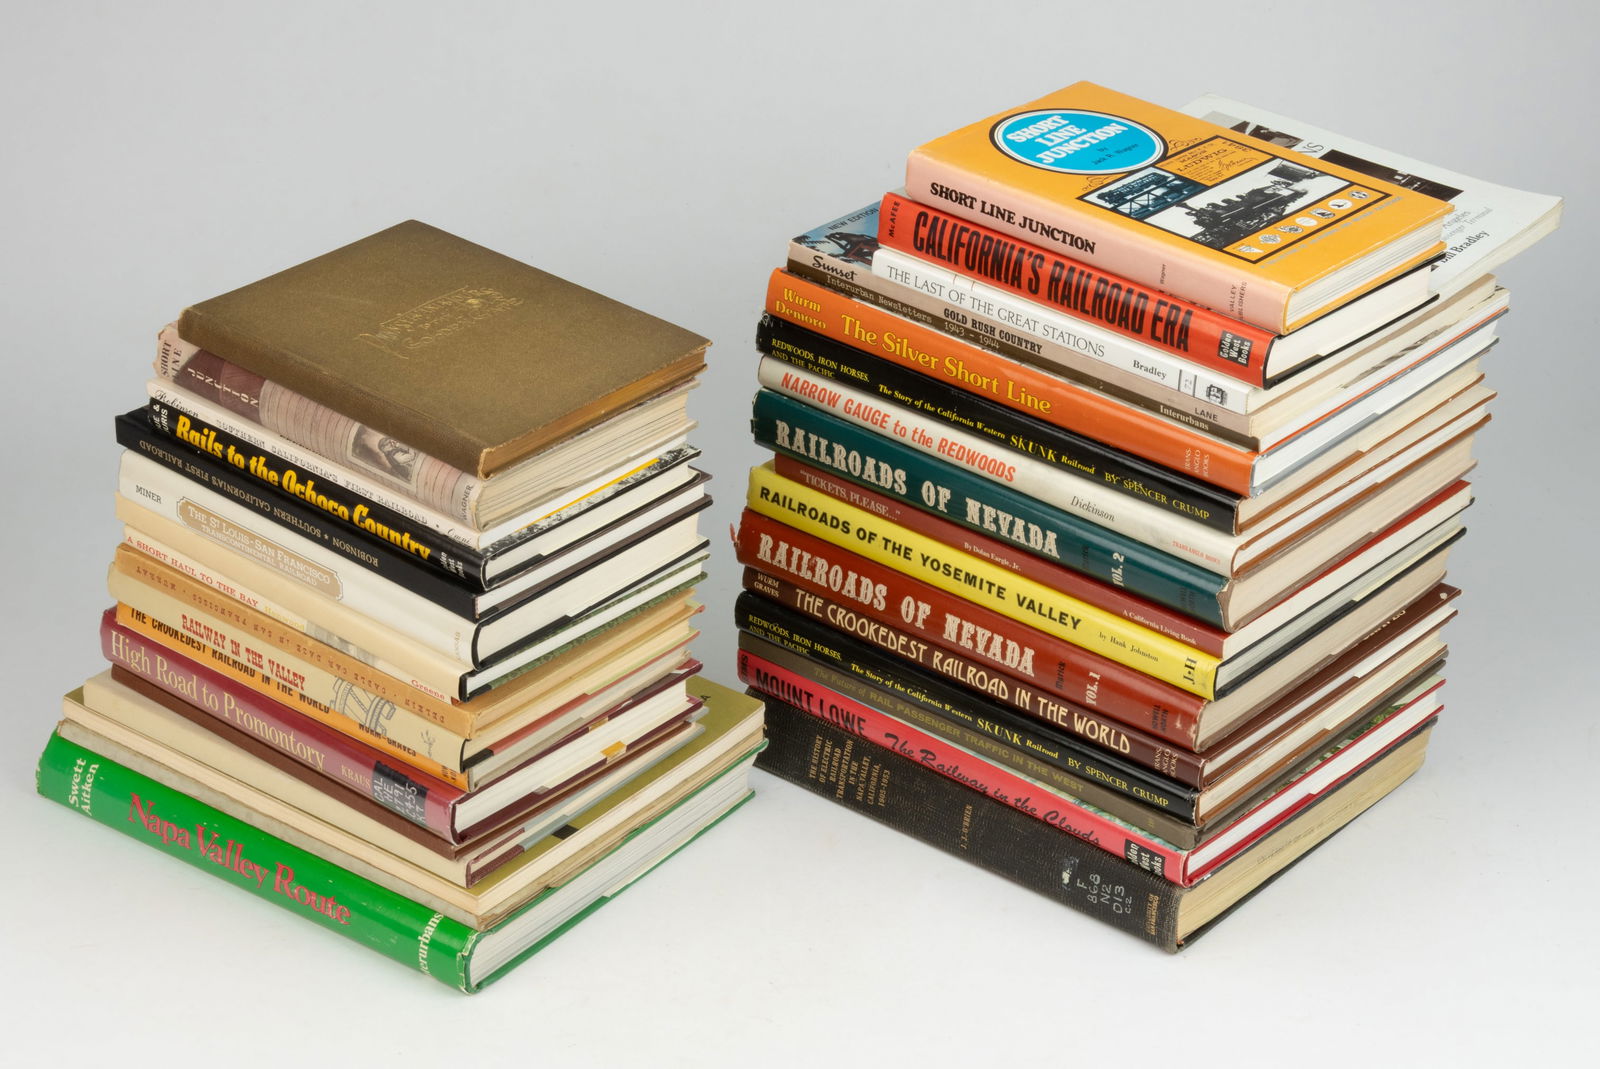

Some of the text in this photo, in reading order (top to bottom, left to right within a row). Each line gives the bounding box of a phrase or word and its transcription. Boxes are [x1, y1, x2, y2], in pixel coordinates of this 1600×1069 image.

[1006, 115, 1070, 142] SHORT
[1035, 125, 1087, 147] LINE
[1036, 123, 1129, 164] JUNCTION
[828, 207, 880, 232] NEW EDITION
[889, 201, 900, 238] McAFEE
[930, 182, 1096, 255] SHORT LINE JUNCTION
[812, 255, 858, 282] Sunset
[913, 211, 1194, 353] CALIFORNIA'S RAILROAD ERA
[775, 300, 827, 330] Demoro
[783, 287, 822, 313] Wurm
[826, 275, 874, 301] Interurban
[878, 295, 933, 323] Newsletters
[944, 321, 965, 337] 1943
[978, 335, 1001, 351] 1944
[887, 265, 1105, 358] THE LAST OF THE GREAT STATIONS
[944, 308, 1043, 355] GOLD RUSH COUNTRY
[1220, 333, 1234, 358] Golden
[1229, 339, 1241, 358] West
[160, 339, 172, 377] SHORT
[771, 350, 836, 378] AND THE PACIFIC
[841, 314, 1053, 415] The Silver Short Line
[1133, 359, 1167, 380] Bradley
[1238, 341, 1251, 364] Books
[187, 367, 259, 408] JUNCTION
[781, 372, 1016, 484] NARROW GAUGE to the REDWOODS
[878, 384, 1096, 475] The Story of the California Western SKUNK Railroad
[1159, 404, 1209, 431] Interurbans
[1194, 407, 1218, 422] LANE
[136, 484, 162, 505] MINER
[175, 415, 432, 561] Rails to the Ochoco Country
[460, 484, 474, 521] WAGNER
[775, 420, 907, 496] RAILROADS
[921, 480, 951, 513] OF
[966, 497, 1060, 559] NEVADA
[1104, 471, 1210, 520] BY SPENCER CRUMP
[1071, 495, 1115, 523] Dickinson
[760, 486, 1082, 631] RAILROADS OF THE YOSEMITE VALLEY
[964, 542, 1021, 571] By Dolan Eargle, Jr.
[1112, 552, 1125, 587] VOL. 2
[753, 581, 780, 599] GRAVES
[757, 571, 780, 589] WURM
[127, 536, 445, 700] A SHORT HAUL TO THE BAY Greene
[757, 533, 1035, 678] RAILROADS OF NEVADA
[750, 625, 810, 657] AND THE PACIFIC
[1122, 609, 1198, 645] A California Living Book
[181, 613, 306, 691] RAILWAY IN THE VALLEY
[1099, 631, 1159, 664] by Hank Johnston
[795, 588, 1131, 754] THE CROOKEDEST RAILROAD IN THE WORLD
[1086, 671, 1101, 706] VOL. 1
[111, 630, 371, 790] High Road to Promontory KRAUS
[851, 663, 1059, 760] The Story of the California Western SKUNK Railroad
[755, 668, 1100, 846] MOUNT LOWE The Railway in the Clouds
[69, 758, 87, 808] Swett
[80, 763, 100, 816] Aitken
[1067, 757, 1169, 808] BY SPENCER CRUMP
[128, 791, 352, 926] Napa Valley Route
[1077, 878, 1088, 889] F
[1087, 873, 1101, 904] 868
